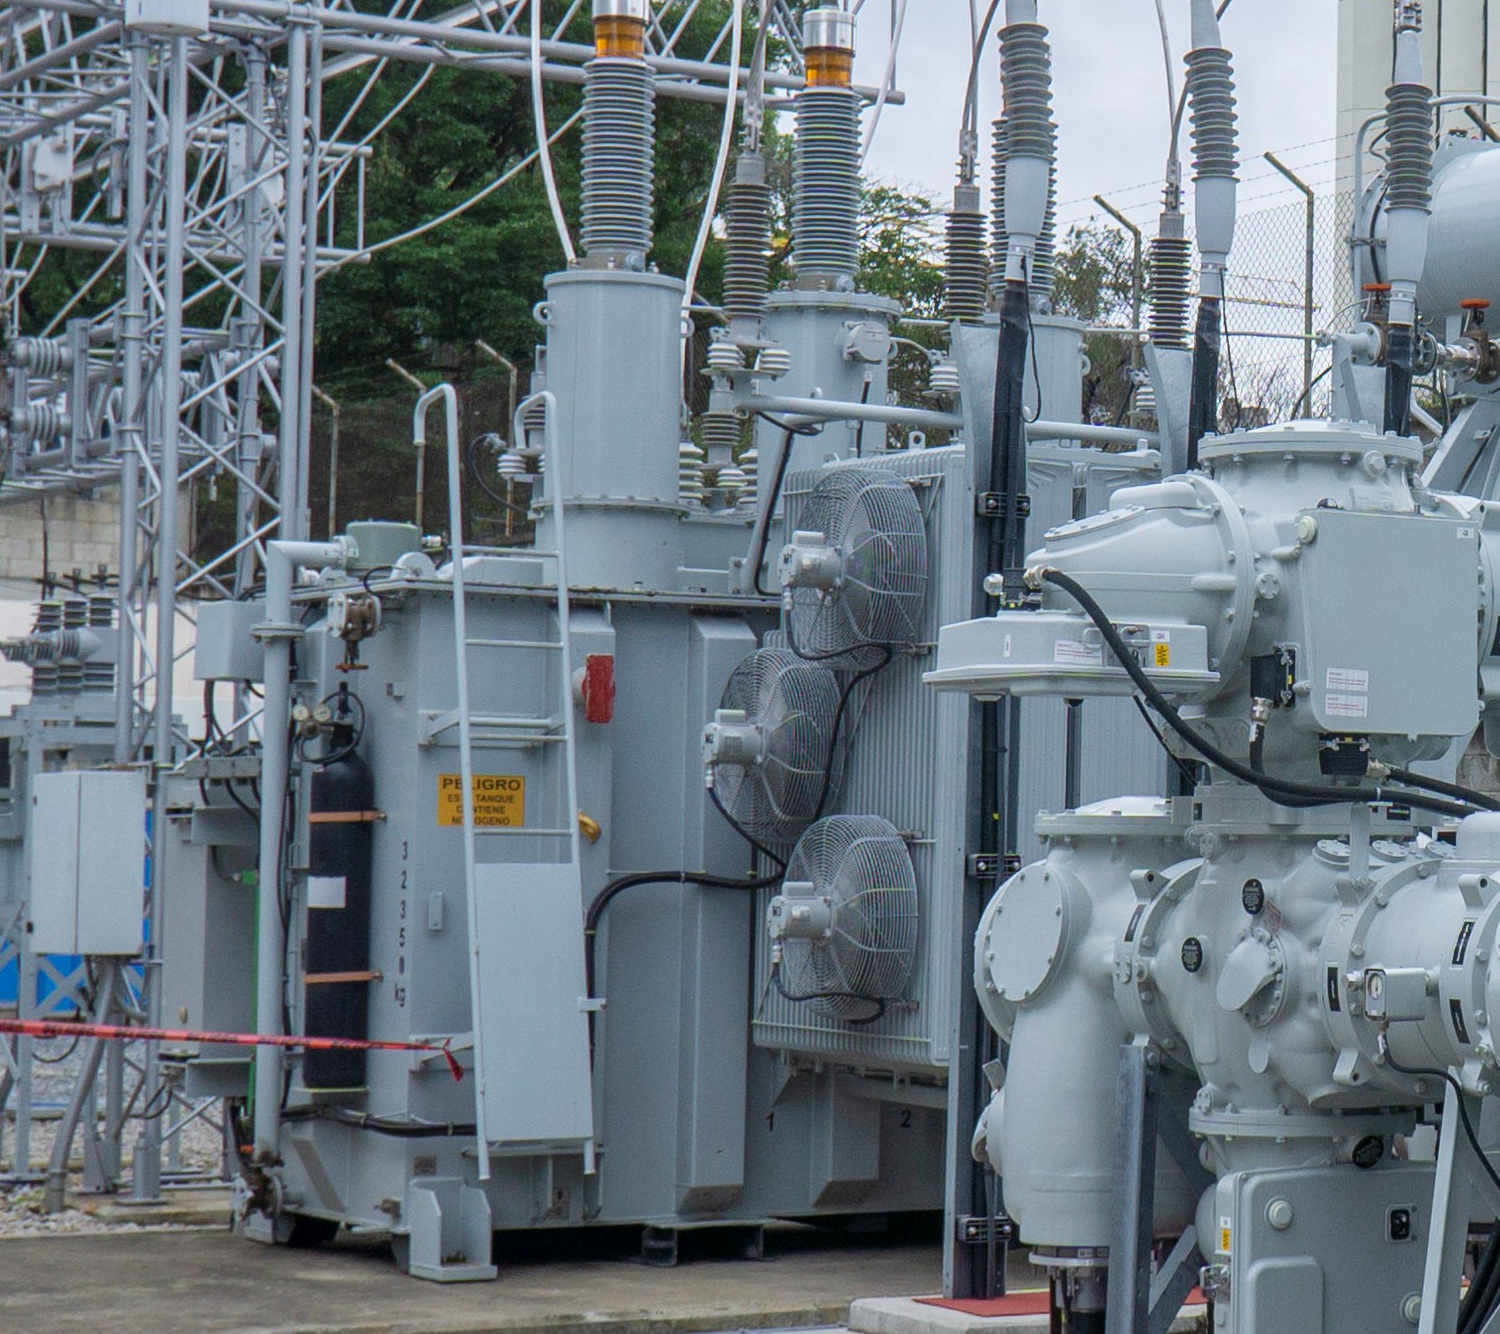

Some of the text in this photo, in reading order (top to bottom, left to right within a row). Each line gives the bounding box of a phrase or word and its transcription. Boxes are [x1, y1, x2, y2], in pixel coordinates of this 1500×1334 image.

[476, 794, 515, 804] TANQUE
[766, 1112, 775, 1132] 1
[900, 1110, 912, 1128] 2
